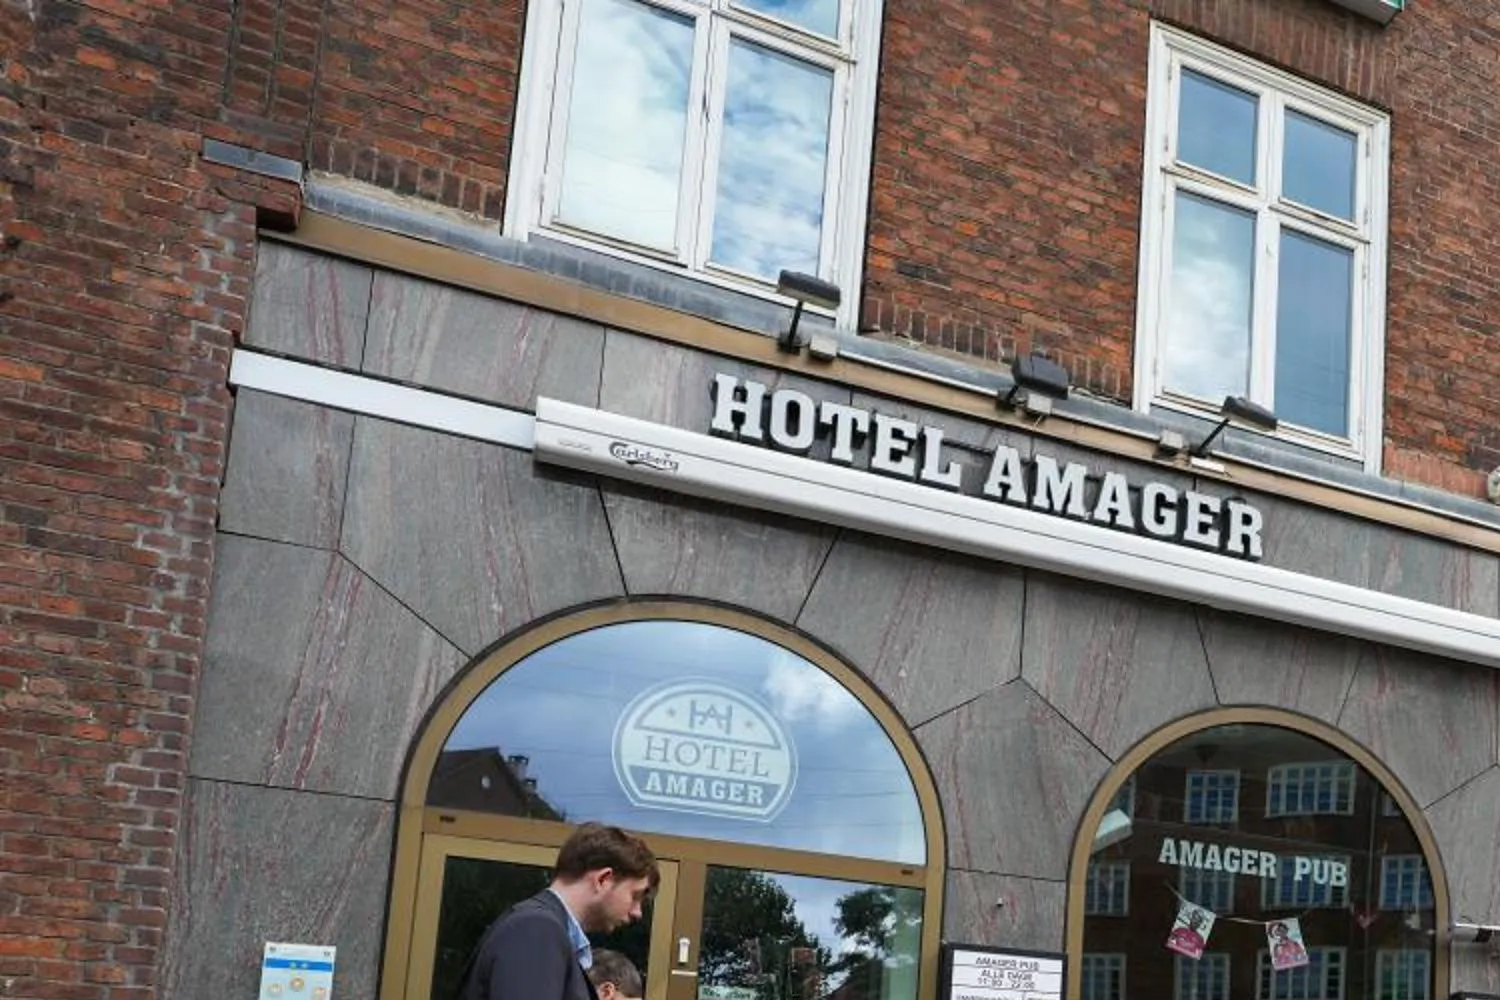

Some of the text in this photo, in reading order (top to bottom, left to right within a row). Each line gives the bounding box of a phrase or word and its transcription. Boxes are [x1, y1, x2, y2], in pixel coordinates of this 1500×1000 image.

[608, 441, 679, 473] Carlsberg
[709, 373, 1264, 561] HOTEL AMAGER
[643, 735, 769, 778] HOTEL
[645, 770, 764, 805] AMAGER
[1158, 837, 1347, 887] AMAGER PUB
